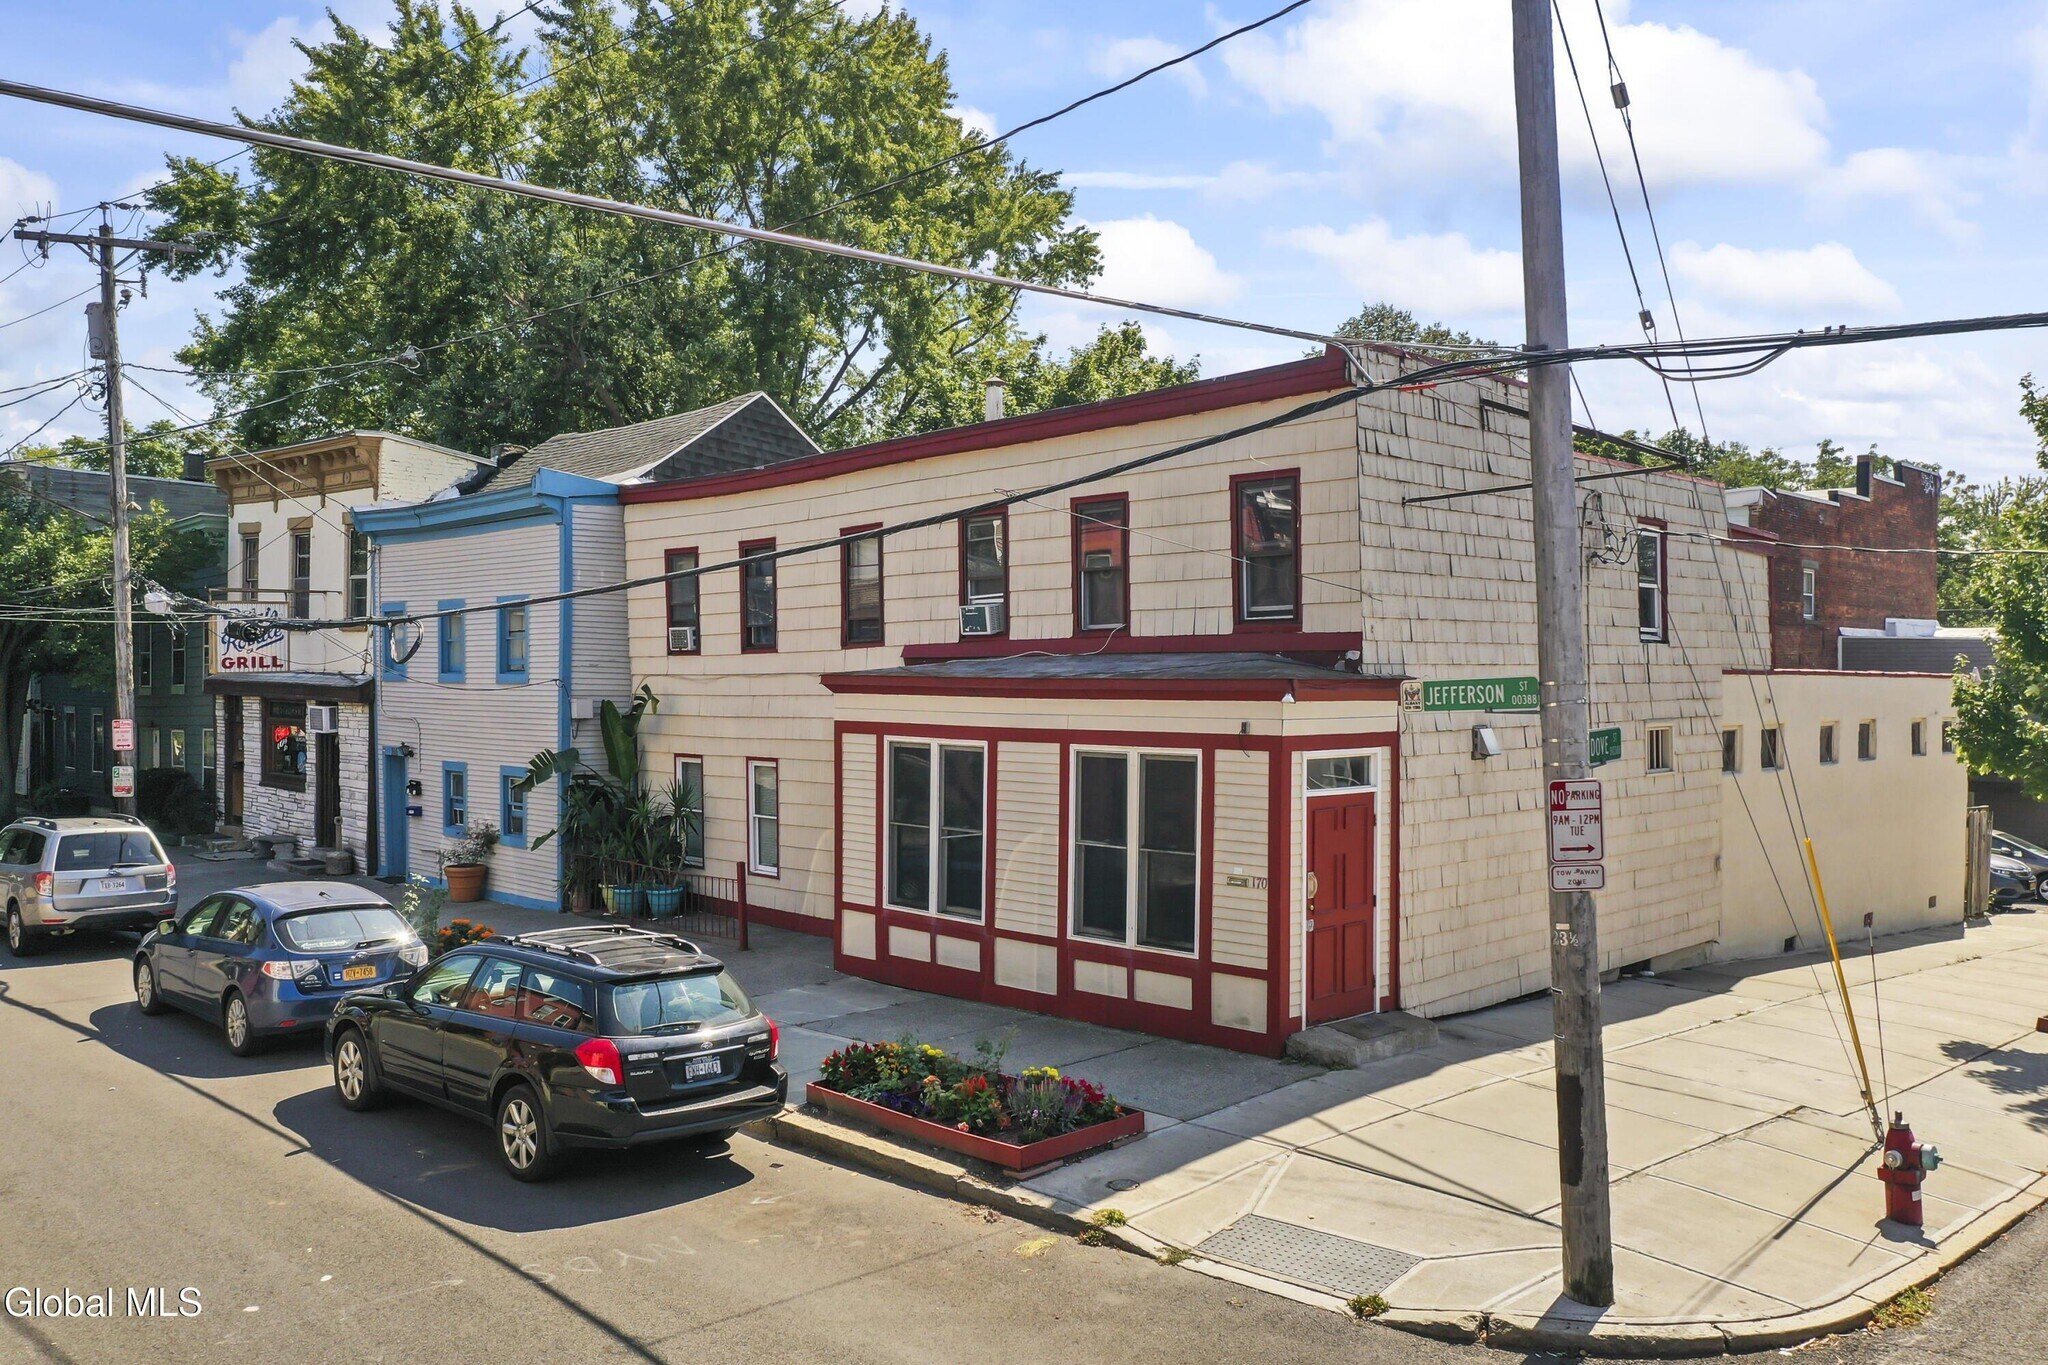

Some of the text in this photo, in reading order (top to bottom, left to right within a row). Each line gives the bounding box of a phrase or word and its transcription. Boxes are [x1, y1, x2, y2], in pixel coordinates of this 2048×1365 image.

[221, 656, 284, 669] GRILL
[1425, 681, 1529, 706] JEFFERSON ST
[1511, 694, 1537, 705] 00388
[1591, 736, 1608, 757] DOVE
[1551, 789, 1600, 805] NO PARKING
[1553, 815, 1570, 825] 9AM
[1579, 814, 1600, 825] 12PM
[1570, 826, 1585, 836] TUE
[1252, 877, 1268, 890] 170
